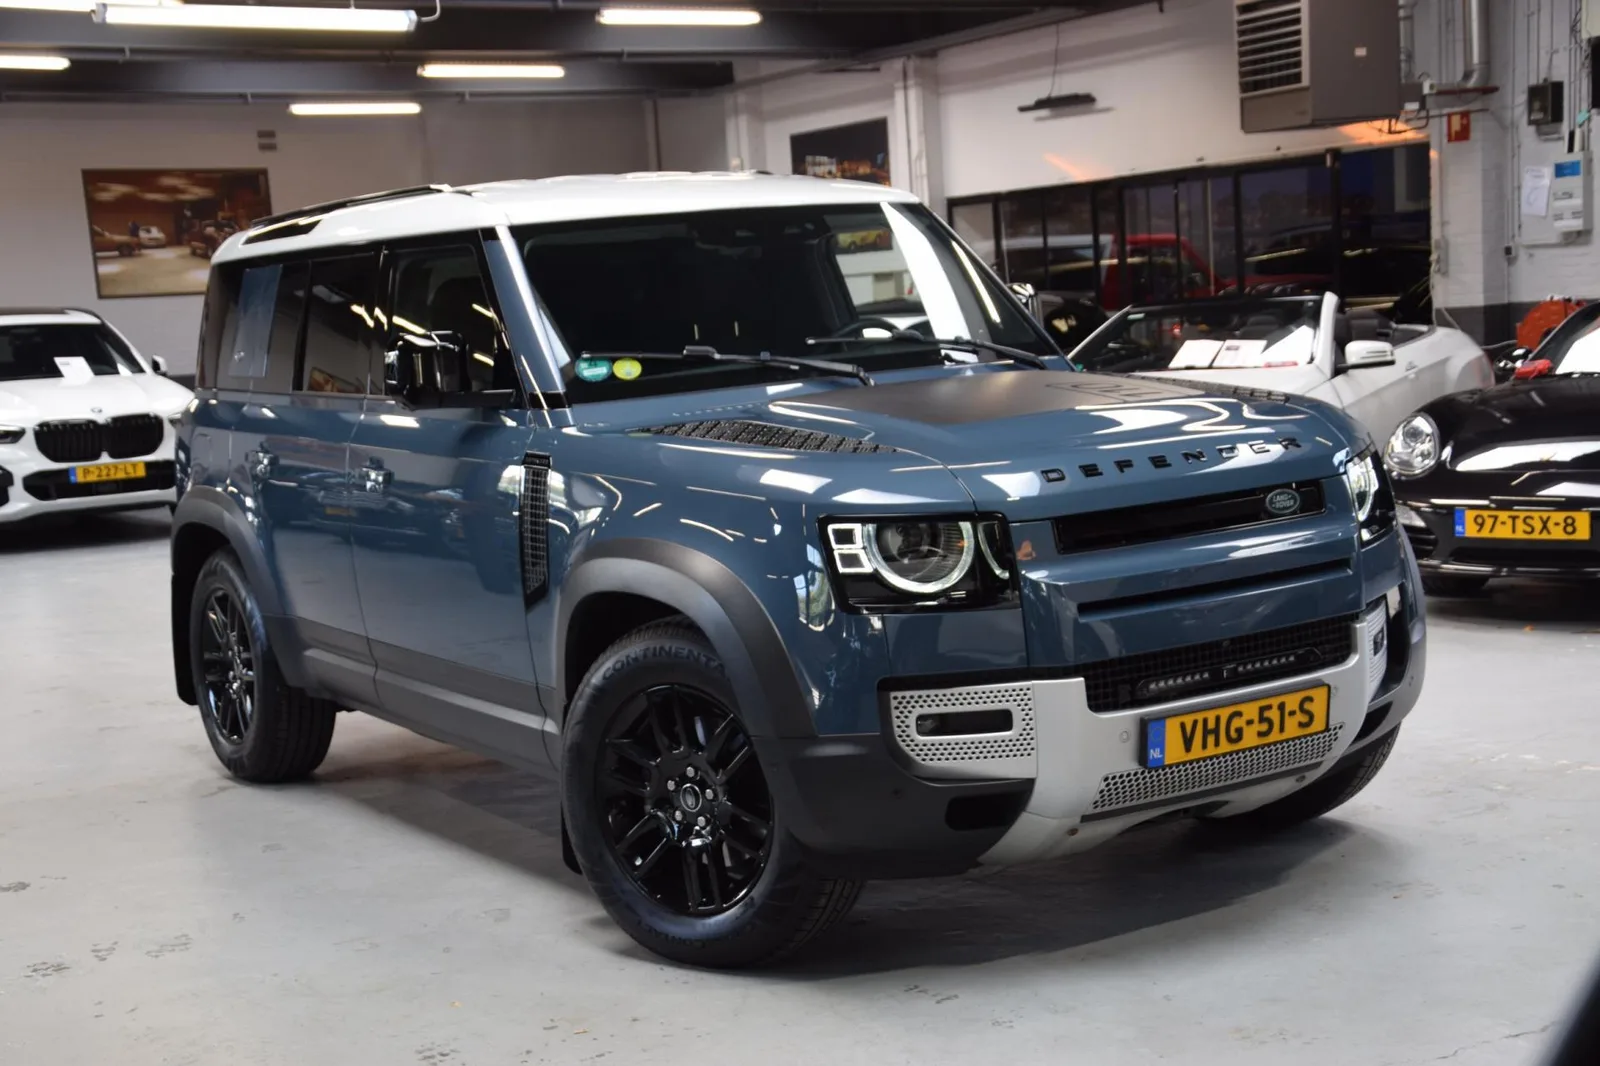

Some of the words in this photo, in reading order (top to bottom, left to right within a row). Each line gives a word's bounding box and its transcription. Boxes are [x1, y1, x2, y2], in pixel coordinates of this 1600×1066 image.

[82, 463, 138, 479] P-227-LT
[1040, 437, 1301, 483] DEFENDER
[1473, 514, 1577, 535] 97-TSX-8
[602, 646, 731, 682] CONTINENTA
[1180, 695, 1315, 753] VHG-51-S
[1149, 748, 1163, 759] NL
